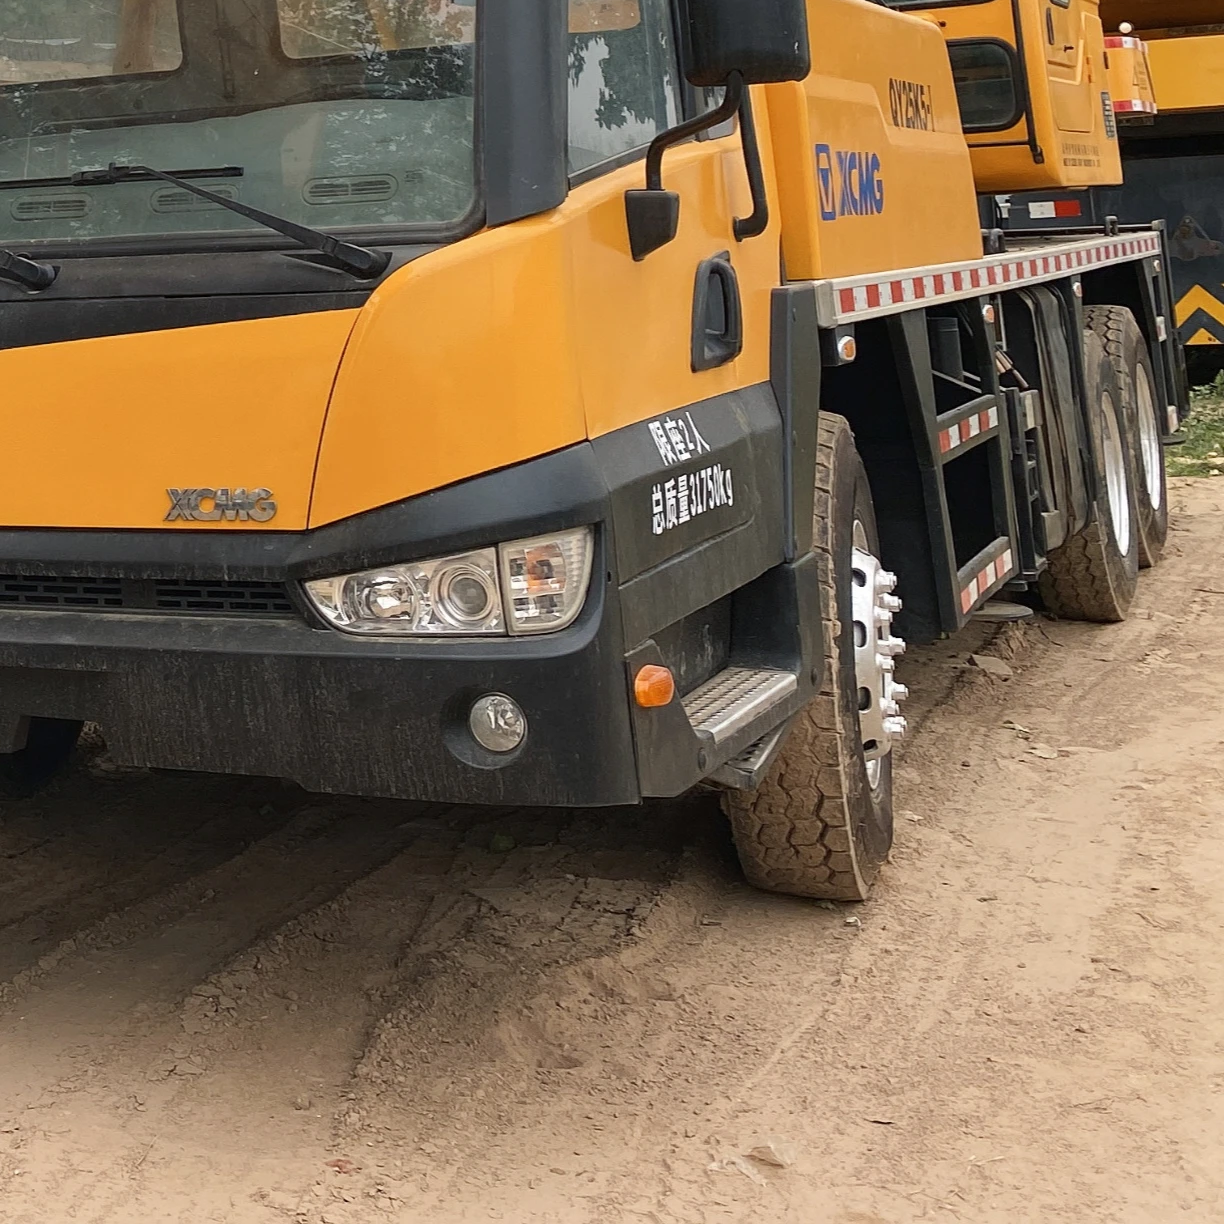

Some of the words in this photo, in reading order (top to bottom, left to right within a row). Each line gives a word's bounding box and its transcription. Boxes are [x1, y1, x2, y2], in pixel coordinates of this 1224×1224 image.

[836, 151, 884, 216] XCMG
[648, 411, 711, 467] 限座2人
[163, 487, 277, 523] XCMG
